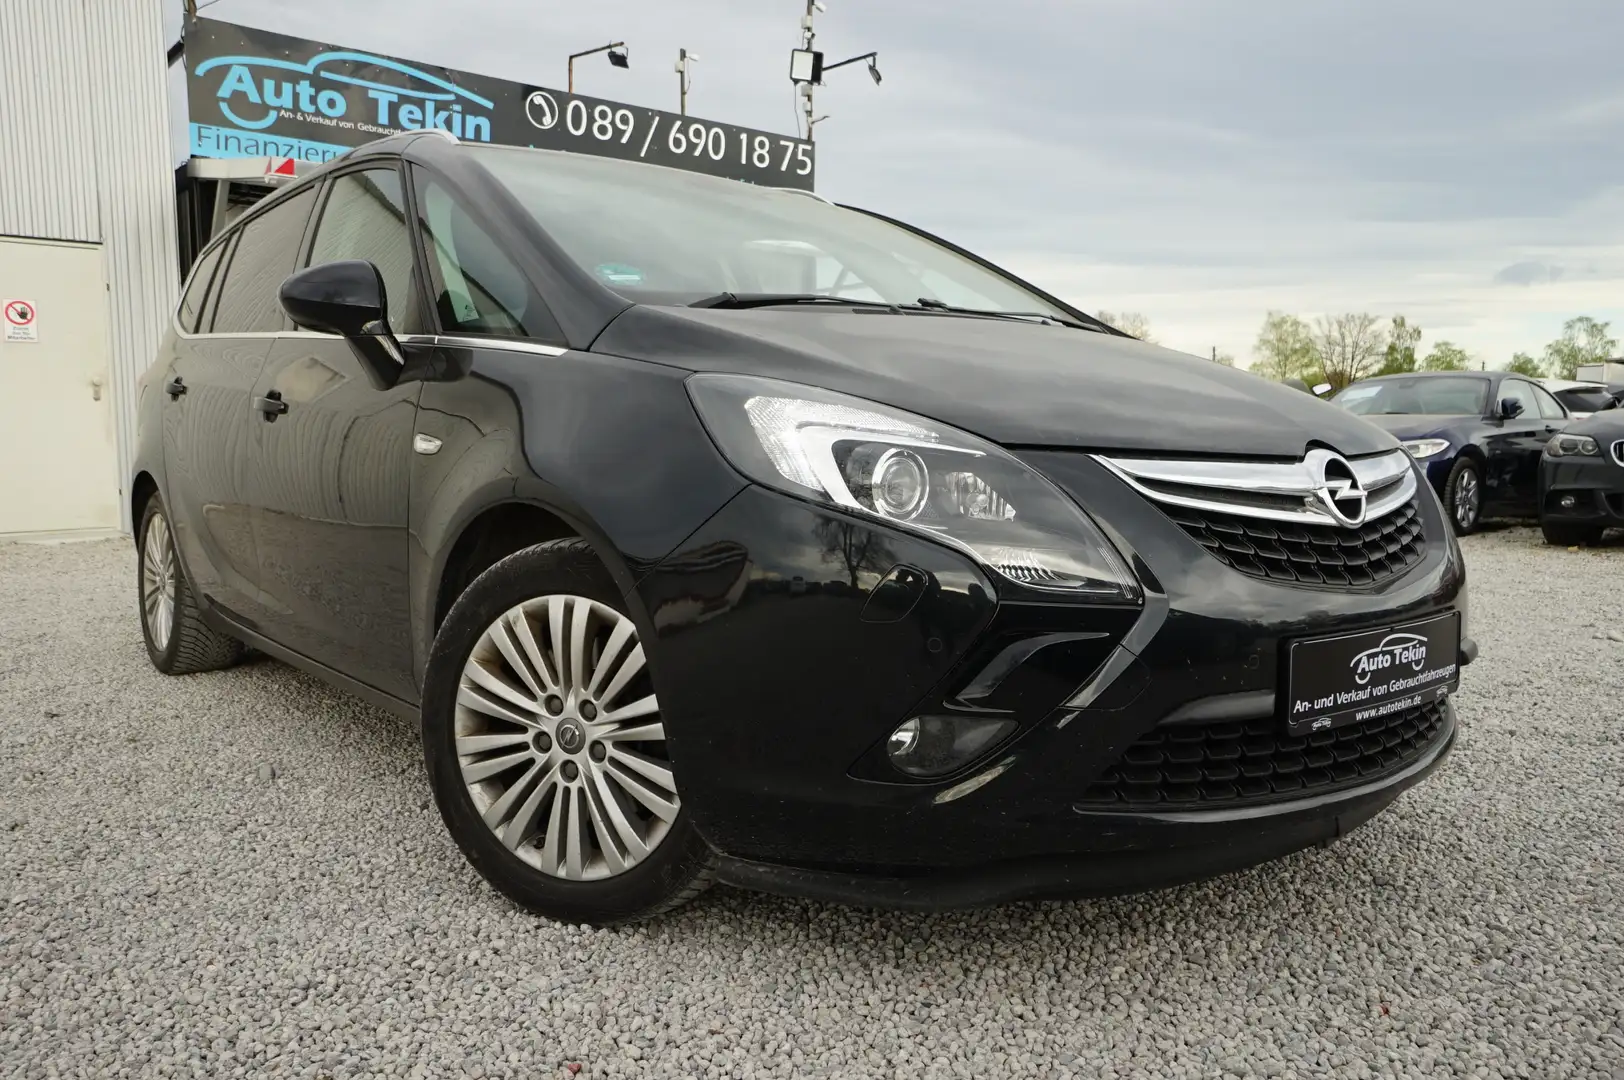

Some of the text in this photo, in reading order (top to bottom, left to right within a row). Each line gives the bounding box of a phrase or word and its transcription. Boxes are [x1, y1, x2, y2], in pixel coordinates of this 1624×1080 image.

[217, 65, 491, 143] Auto Tekin
[305, 114, 337, 127] Verkauf
[338, 121, 355, 130] von
[566, 100, 634, 144] 089
[668, 120, 726, 161] 690
[740, 133, 770, 168] 18
[780, 140, 812, 175] 75
[1357, 646, 1426, 673] Auto Tekin
[1293, 700, 1312, 714] An-
[1314, 694, 1334, 710] und
[1336, 686, 1371, 705] Verkauf
[1372, 685, 1388, 698] von
[1389, 663, 1456, 693] Gebrauchtfahrzeugen
[1355, 695, 1422, 721] www.autotekin.de
